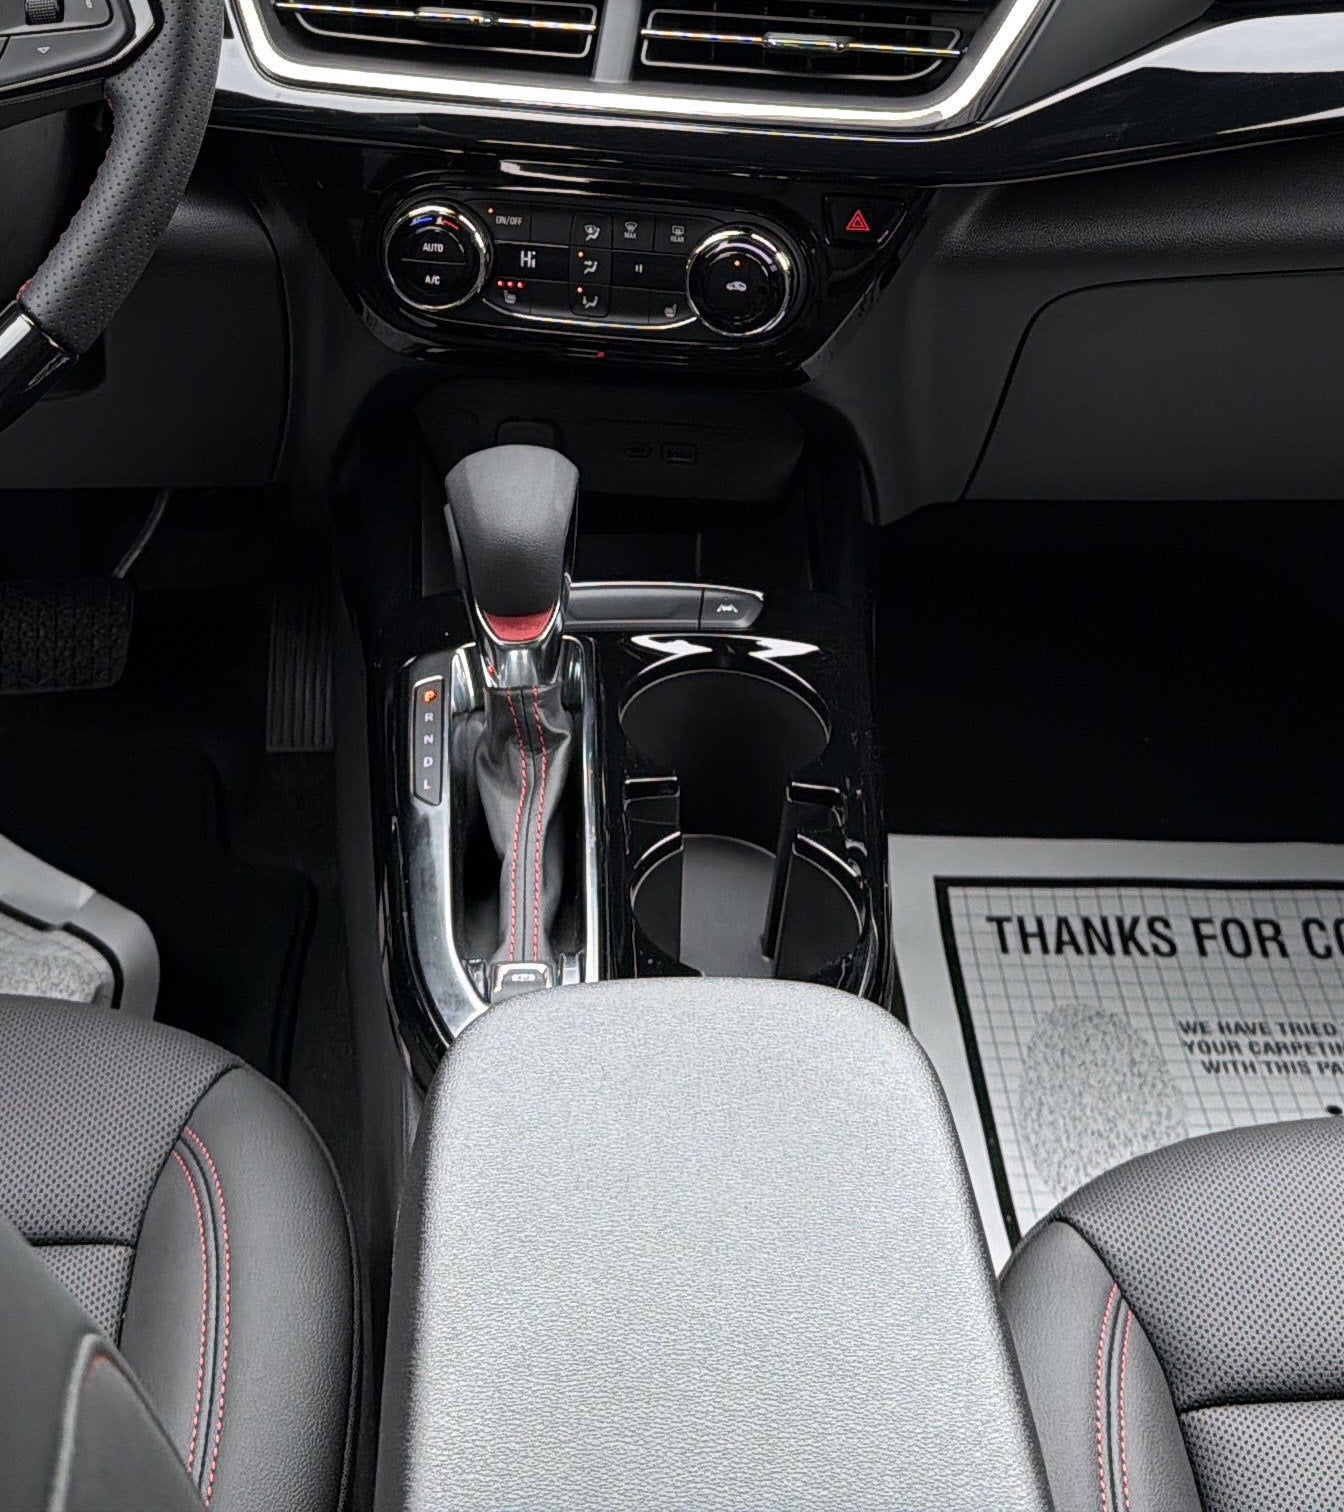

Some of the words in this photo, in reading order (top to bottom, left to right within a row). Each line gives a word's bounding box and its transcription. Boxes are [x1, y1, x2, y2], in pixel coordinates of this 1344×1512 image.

[496, 215, 523, 226] ON/OFF
[422, 242, 444, 253] AUTO
[520, 250, 536, 268] Hi
[424, 274, 441, 285] A/C
[424, 712, 434, 723] R
[423, 734, 434, 745] N
[423, 756, 434, 768] D
[423, 778, 431, 790] L
[986, 914, 1178, 958] THANKS
[1190, 916, 1289, 959] FOR
[1178, 1020, 1212, 1036] WE
[1217, 1021, 1273, 1037] HAVE
[1276, 1021, 1338, 1037] TRIED
[1183, 1039, 1243, 1056] YOUR
[1200, 1059, 1258, 1075] WITH
[1263, 1060, 1312, 1076] THIS
